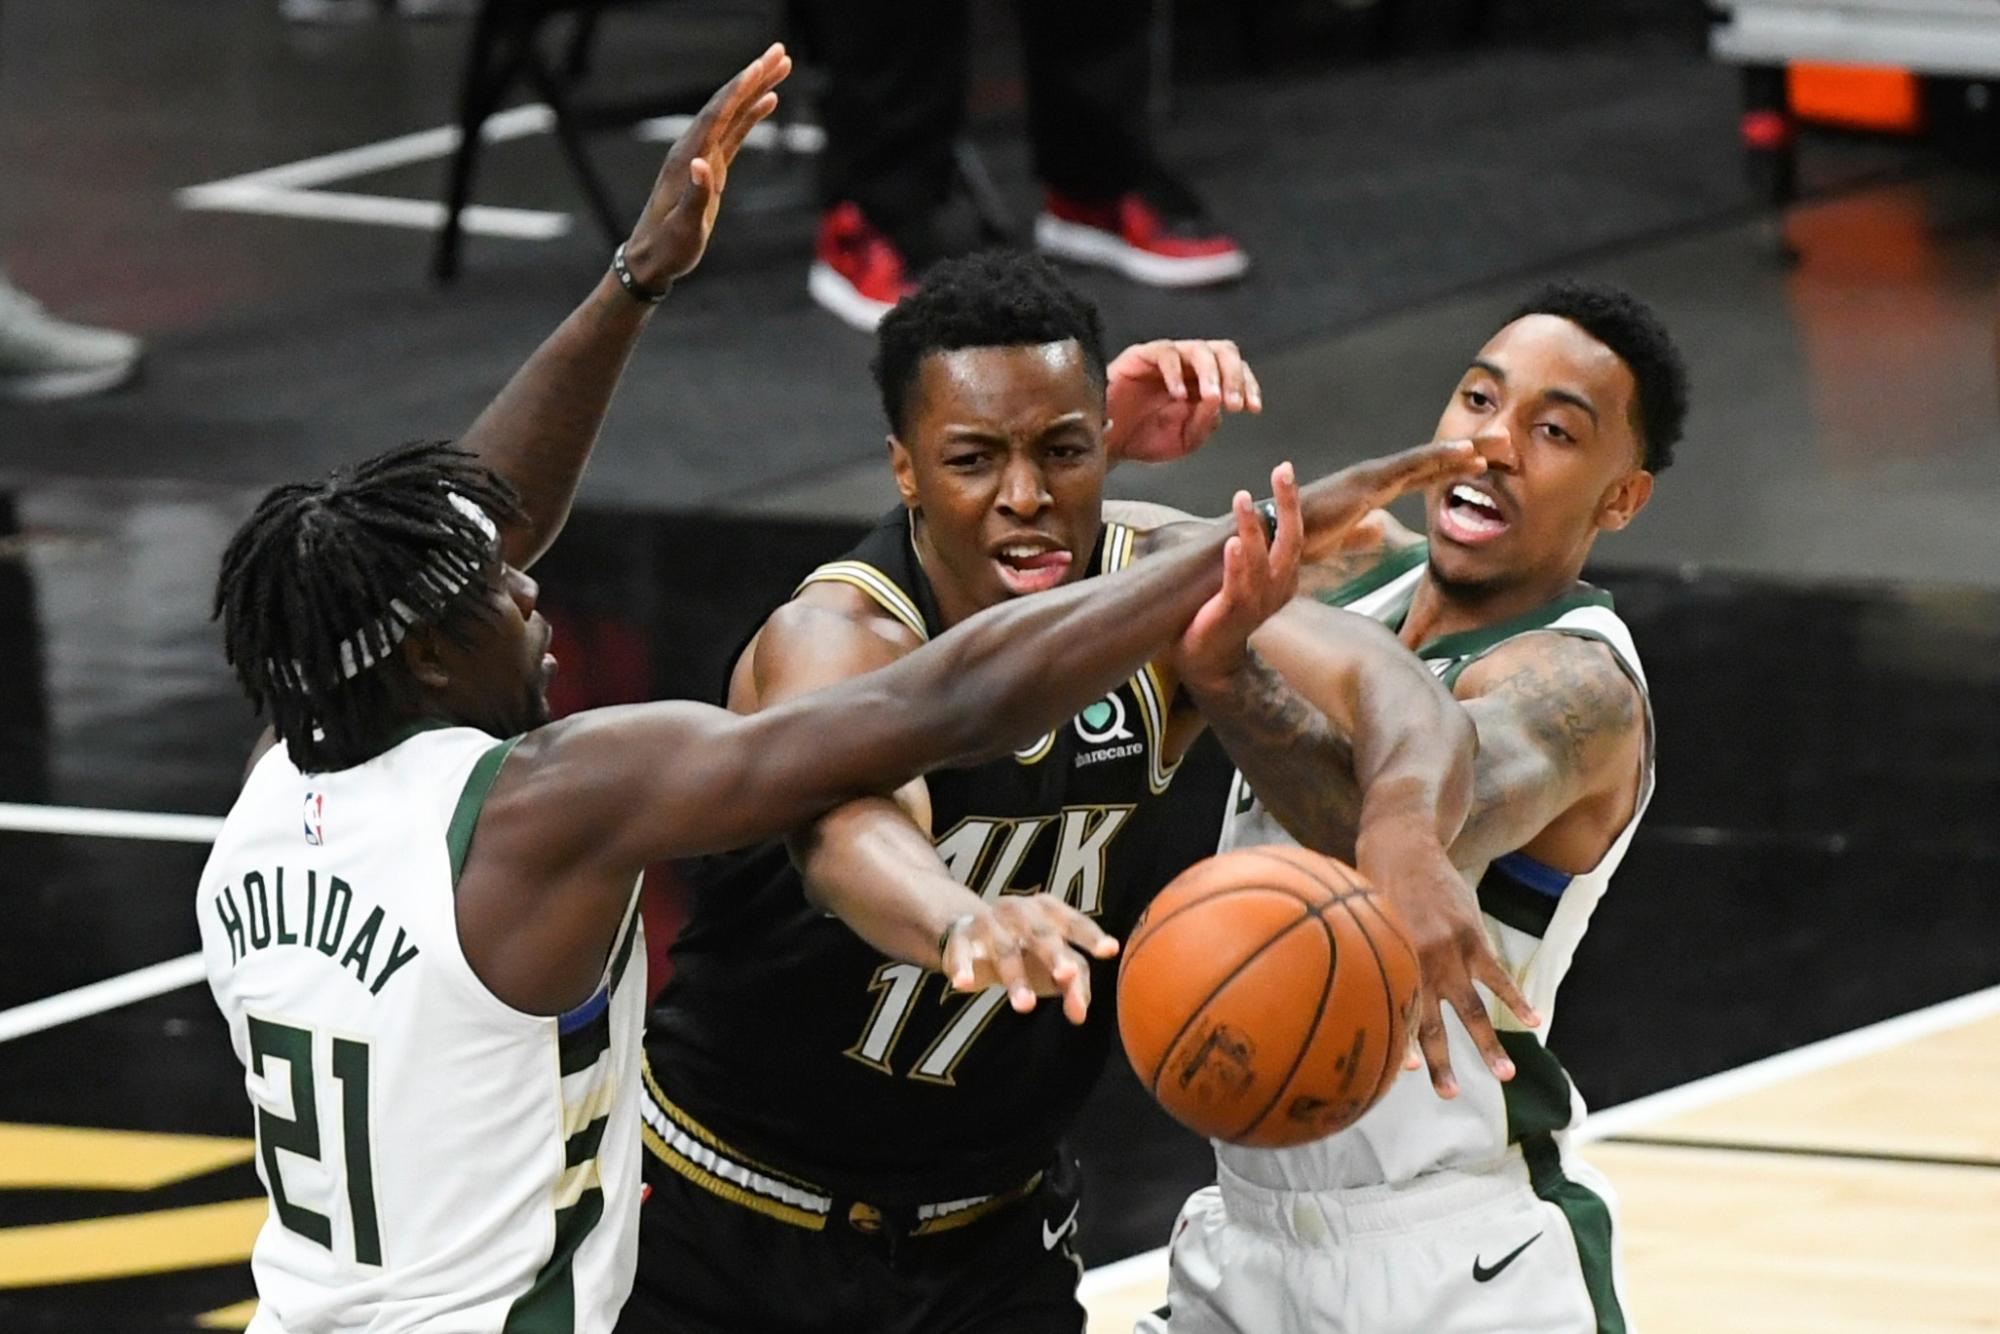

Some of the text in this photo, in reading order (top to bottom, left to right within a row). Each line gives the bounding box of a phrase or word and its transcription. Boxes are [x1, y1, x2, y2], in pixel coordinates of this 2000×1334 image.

[215, 866, 420, 997] HOLIDAY
[842, 960, 1014, 1087] 17
[246, 1013, 385, 1269] 21
